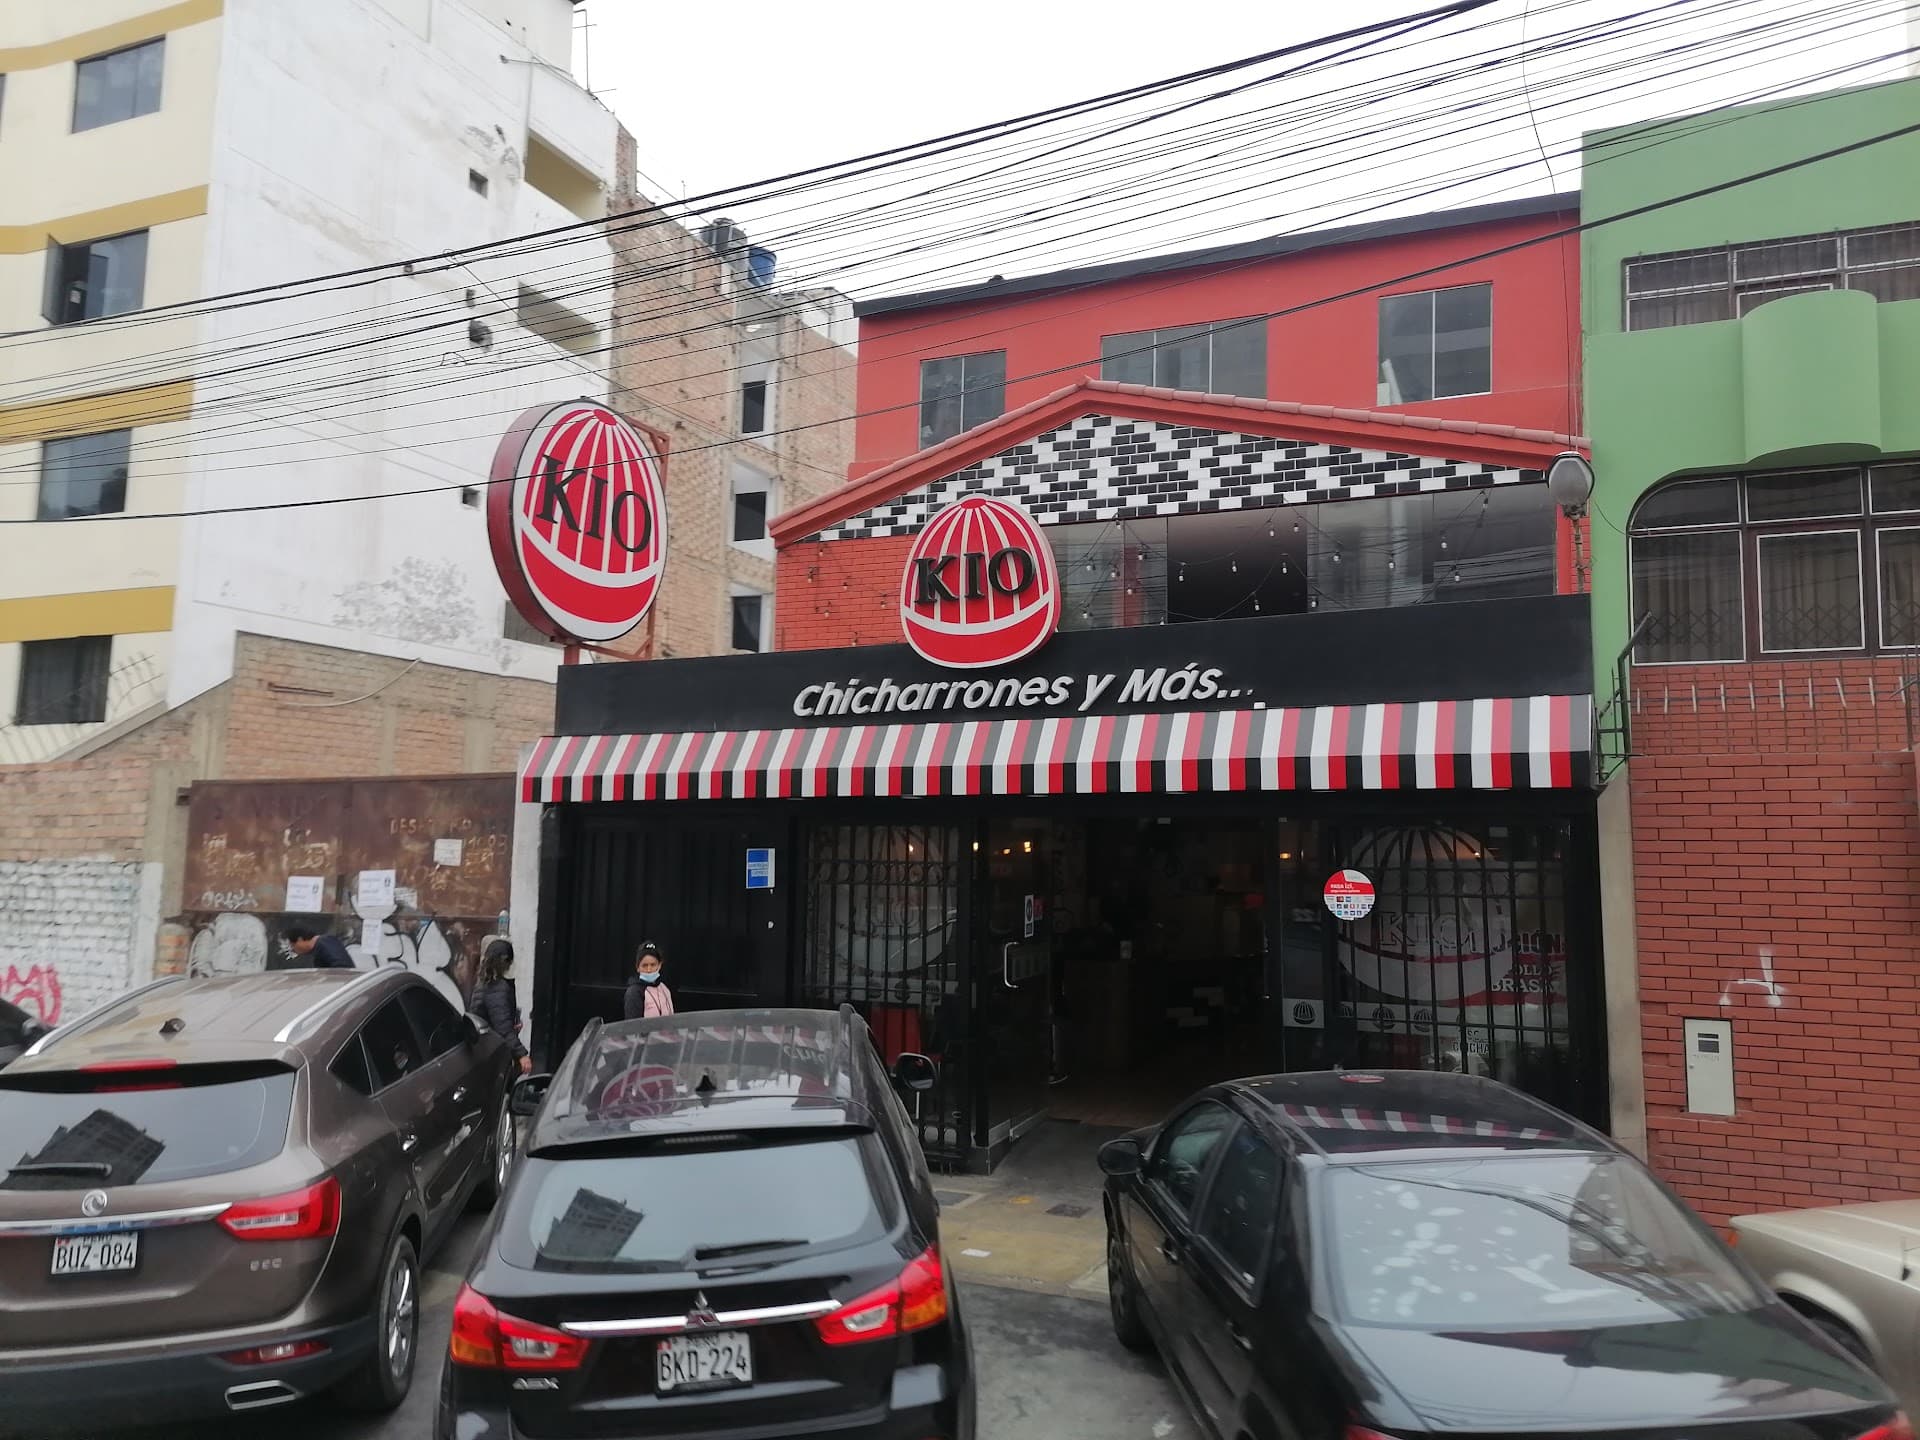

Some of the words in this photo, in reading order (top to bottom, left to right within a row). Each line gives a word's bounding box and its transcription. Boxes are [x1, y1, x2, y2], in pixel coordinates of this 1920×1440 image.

[536, 454, 652, 553] KIO
[912, 547, 1037, 604] KIO
[793, 674, 1075, 717] Chicharrones
[1078, 672, 1116, 711] y
[56, 1242, 134, 1270] BUZ-084
[660, 1344, 746, 1381] BKD-224
